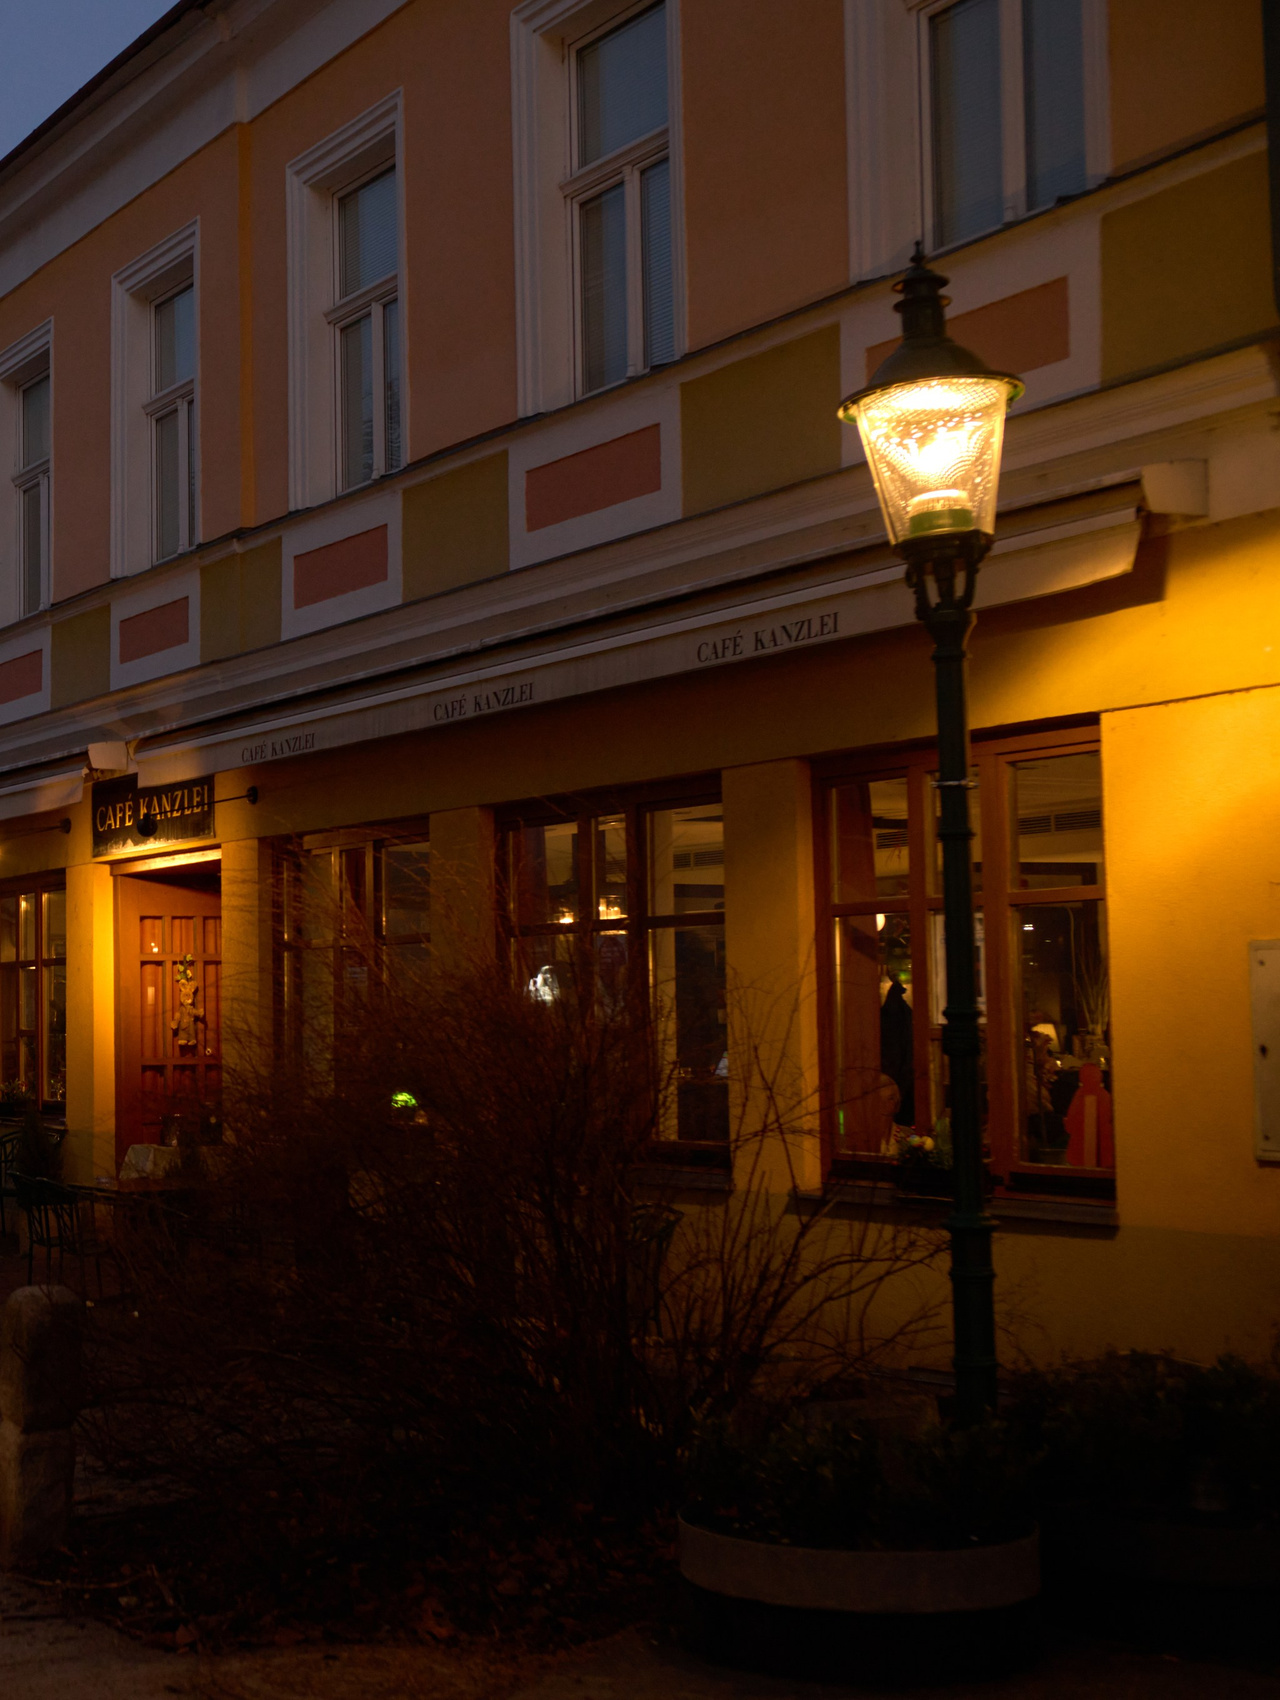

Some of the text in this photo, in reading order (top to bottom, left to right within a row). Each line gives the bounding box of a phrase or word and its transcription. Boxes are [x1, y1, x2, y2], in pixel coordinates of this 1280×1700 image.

[697, 612, 839, 662] CAFÉ KANZLEI
[434, 682, 535, 722] CAFÉ KANZLEI
[241, 733, 316, 763] CAFÉ KANZLEI
[96, 784, 209, 832] CAFÉ KANZLEI
